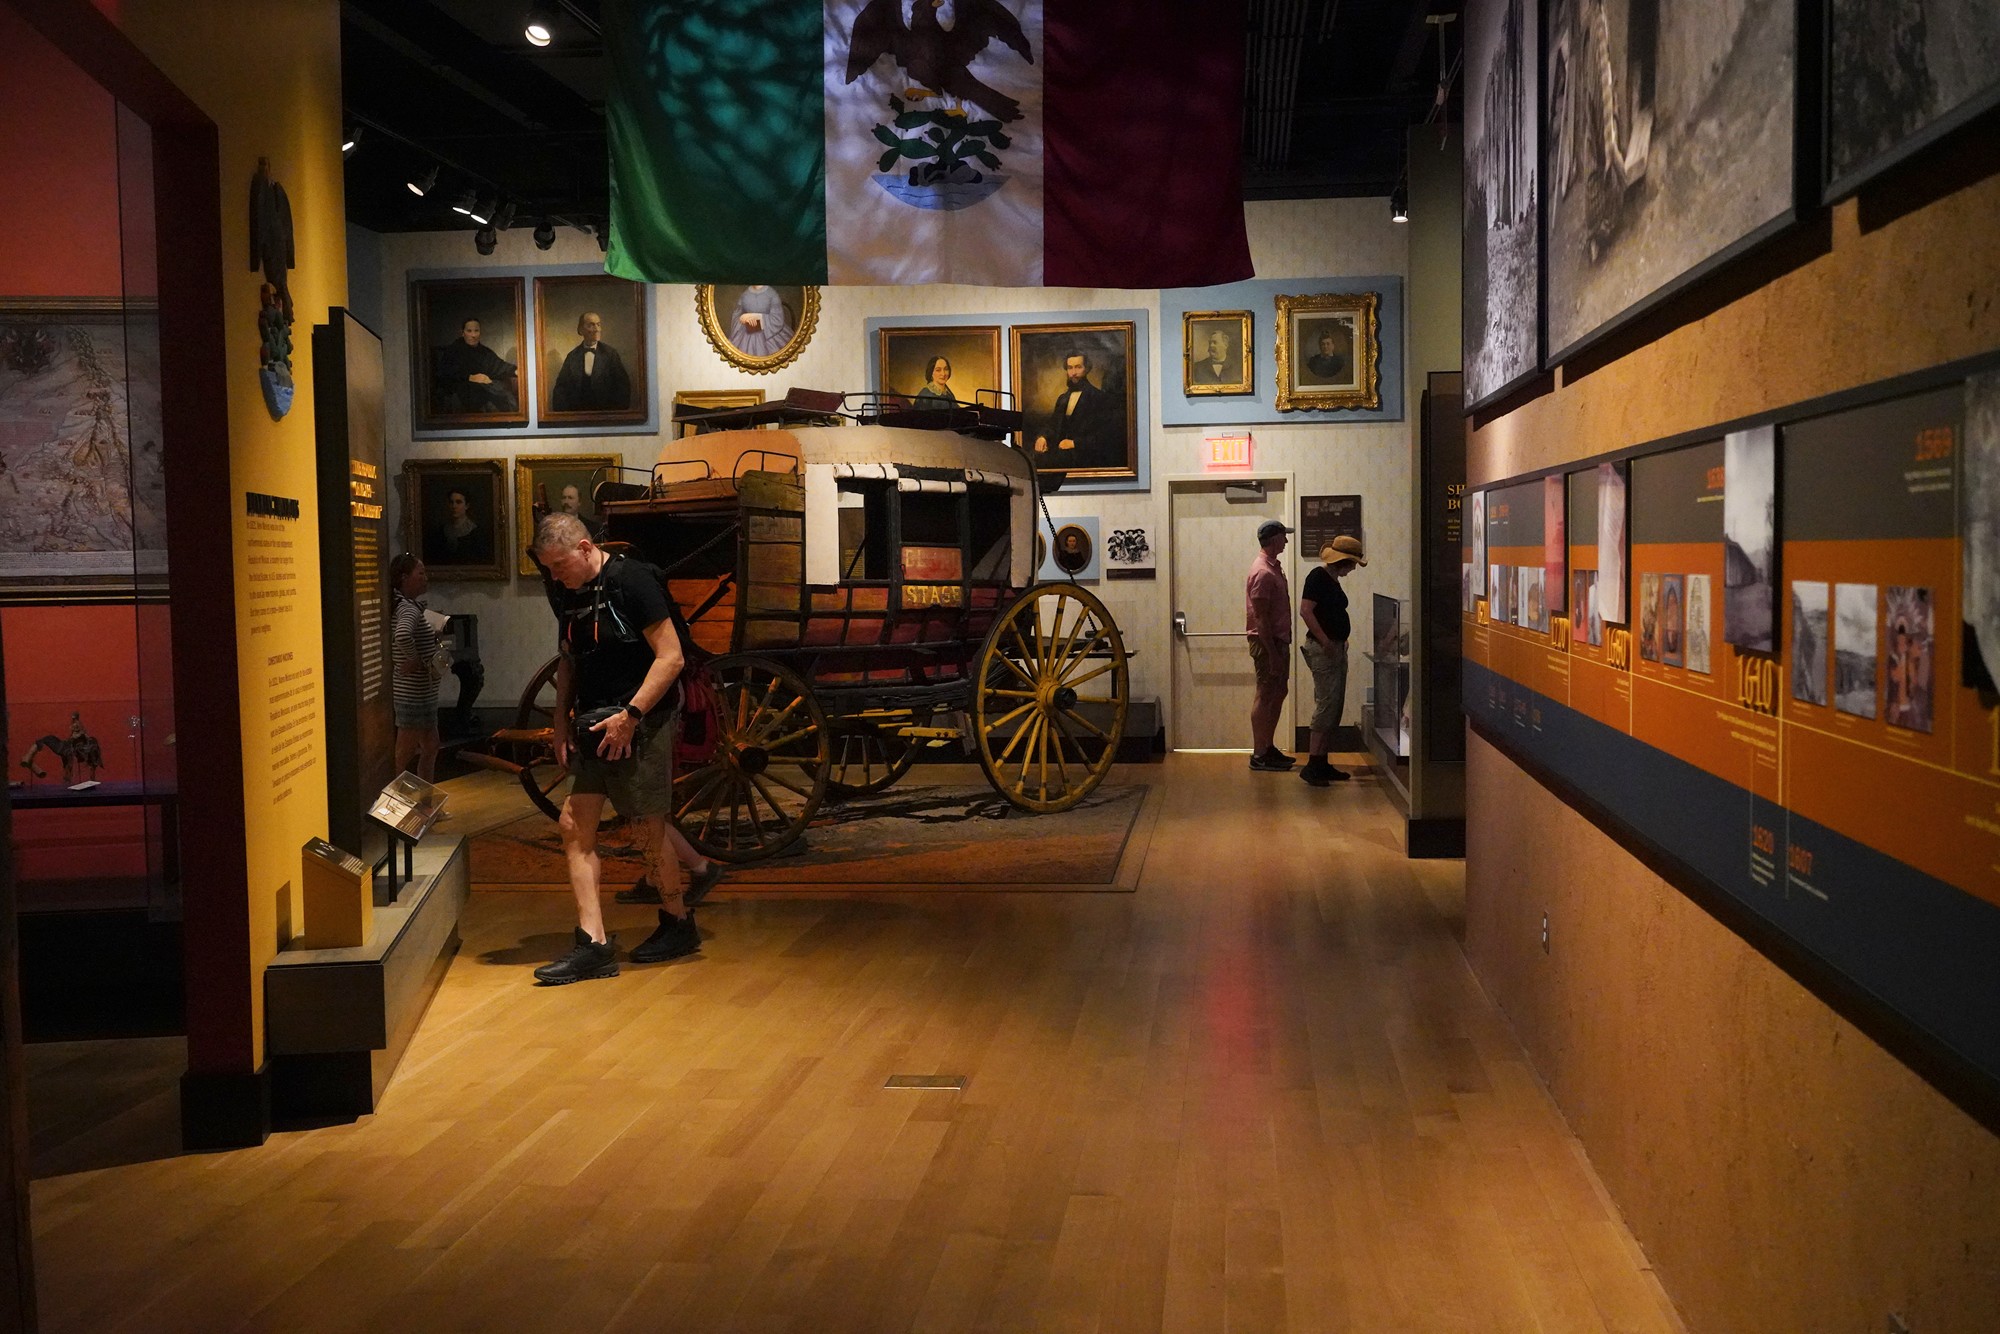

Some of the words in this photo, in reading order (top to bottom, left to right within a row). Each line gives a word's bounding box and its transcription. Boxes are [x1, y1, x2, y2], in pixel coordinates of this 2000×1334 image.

[1211, 440, 1245, 462] EXIT
[906, 585, 961, 604] STAGE
[1606, 627, 1630, 667] 1680
